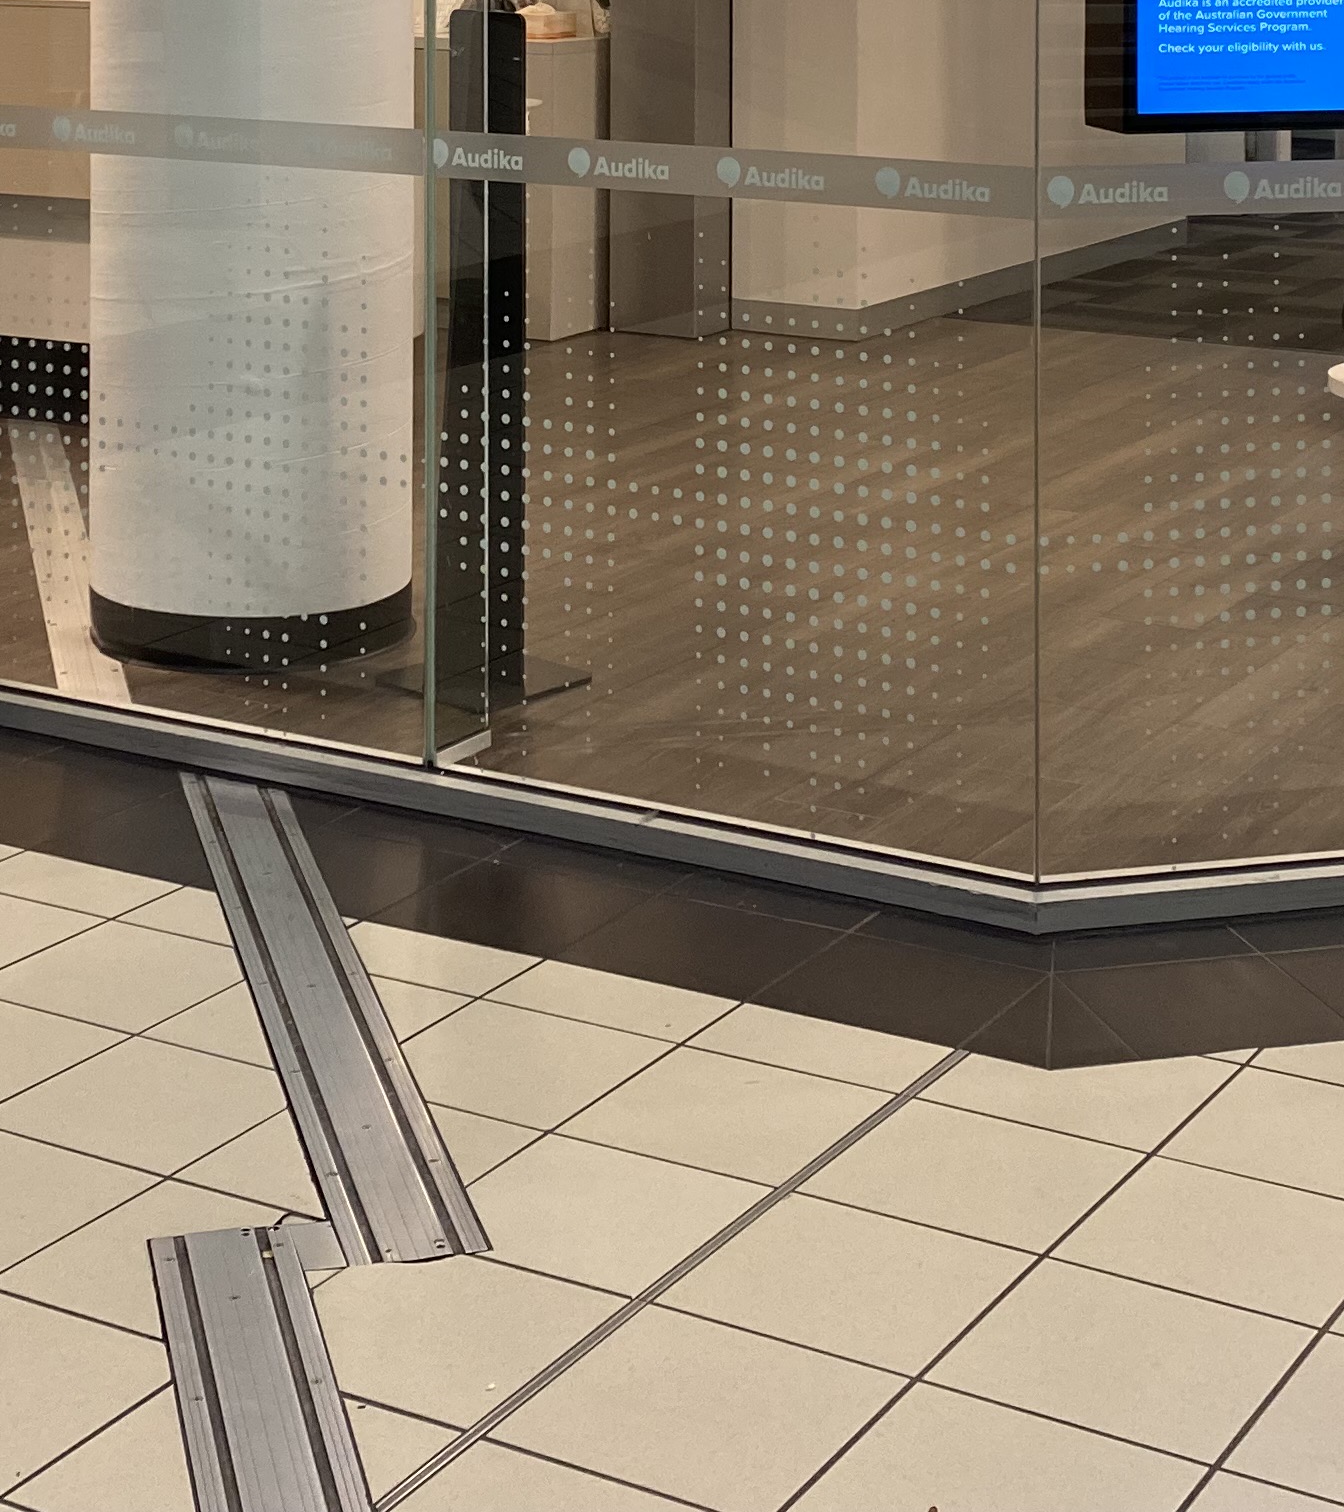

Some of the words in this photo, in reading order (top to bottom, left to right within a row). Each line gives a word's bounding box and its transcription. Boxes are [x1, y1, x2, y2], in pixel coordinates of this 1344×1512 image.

[1158, 10, 1171, 20] of
[1173, 10, 1192, 20] the
[1195, 10, 1254, 20] Australian
[1256, 9, 1328, 19] Government
[1214, 0, 1229, 7] an
[1158, 23, 1205, 35] Hearing
[1207, 22, 1256, 33] Services
[1158, 43, 1195, 53] Check
[1198, 44, 1223, 54] your
[1227, 42, 1279, 54] eligibility
[1282, 42, 1306, 51] with
[451, 146, 524, 172] Audika
[593, 155, 670, 181] Audika
[743, 165, 825, 192] Audika
[903, 175, 990, 203] Audika
[1254, 175, 1342, 201] Audika
[1078, 180, 1169, 205] Audika
